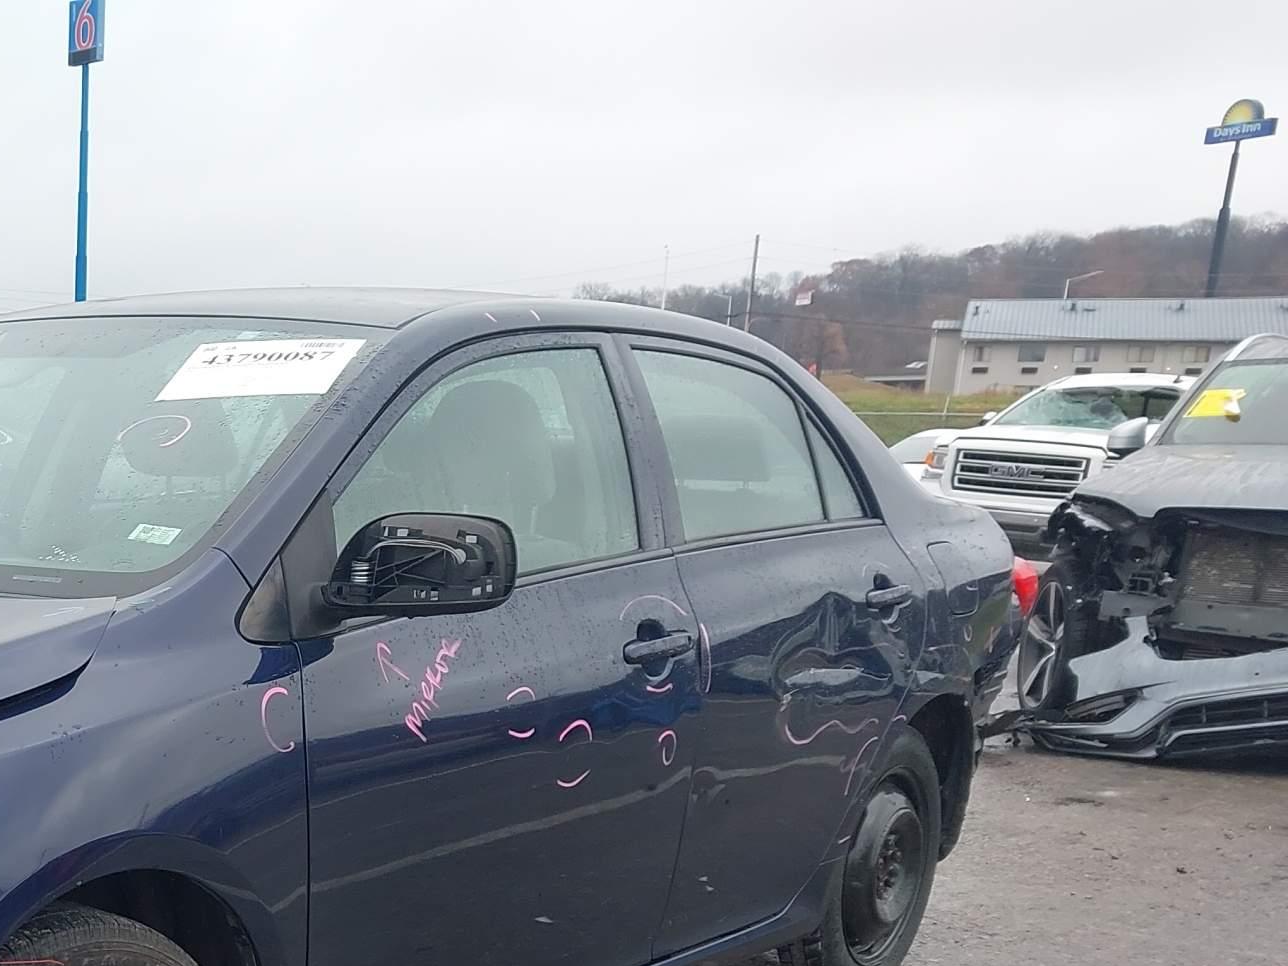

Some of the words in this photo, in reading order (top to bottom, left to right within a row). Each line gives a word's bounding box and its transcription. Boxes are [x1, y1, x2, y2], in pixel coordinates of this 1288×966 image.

[74, 0, 96, 49] 6
[1214, 126, 1241, 138] Days
[1242, 122, 1262, 134] Inn
[201, 350, 336, 366] 43790087
[988, 463, 1047, 481] GMC
